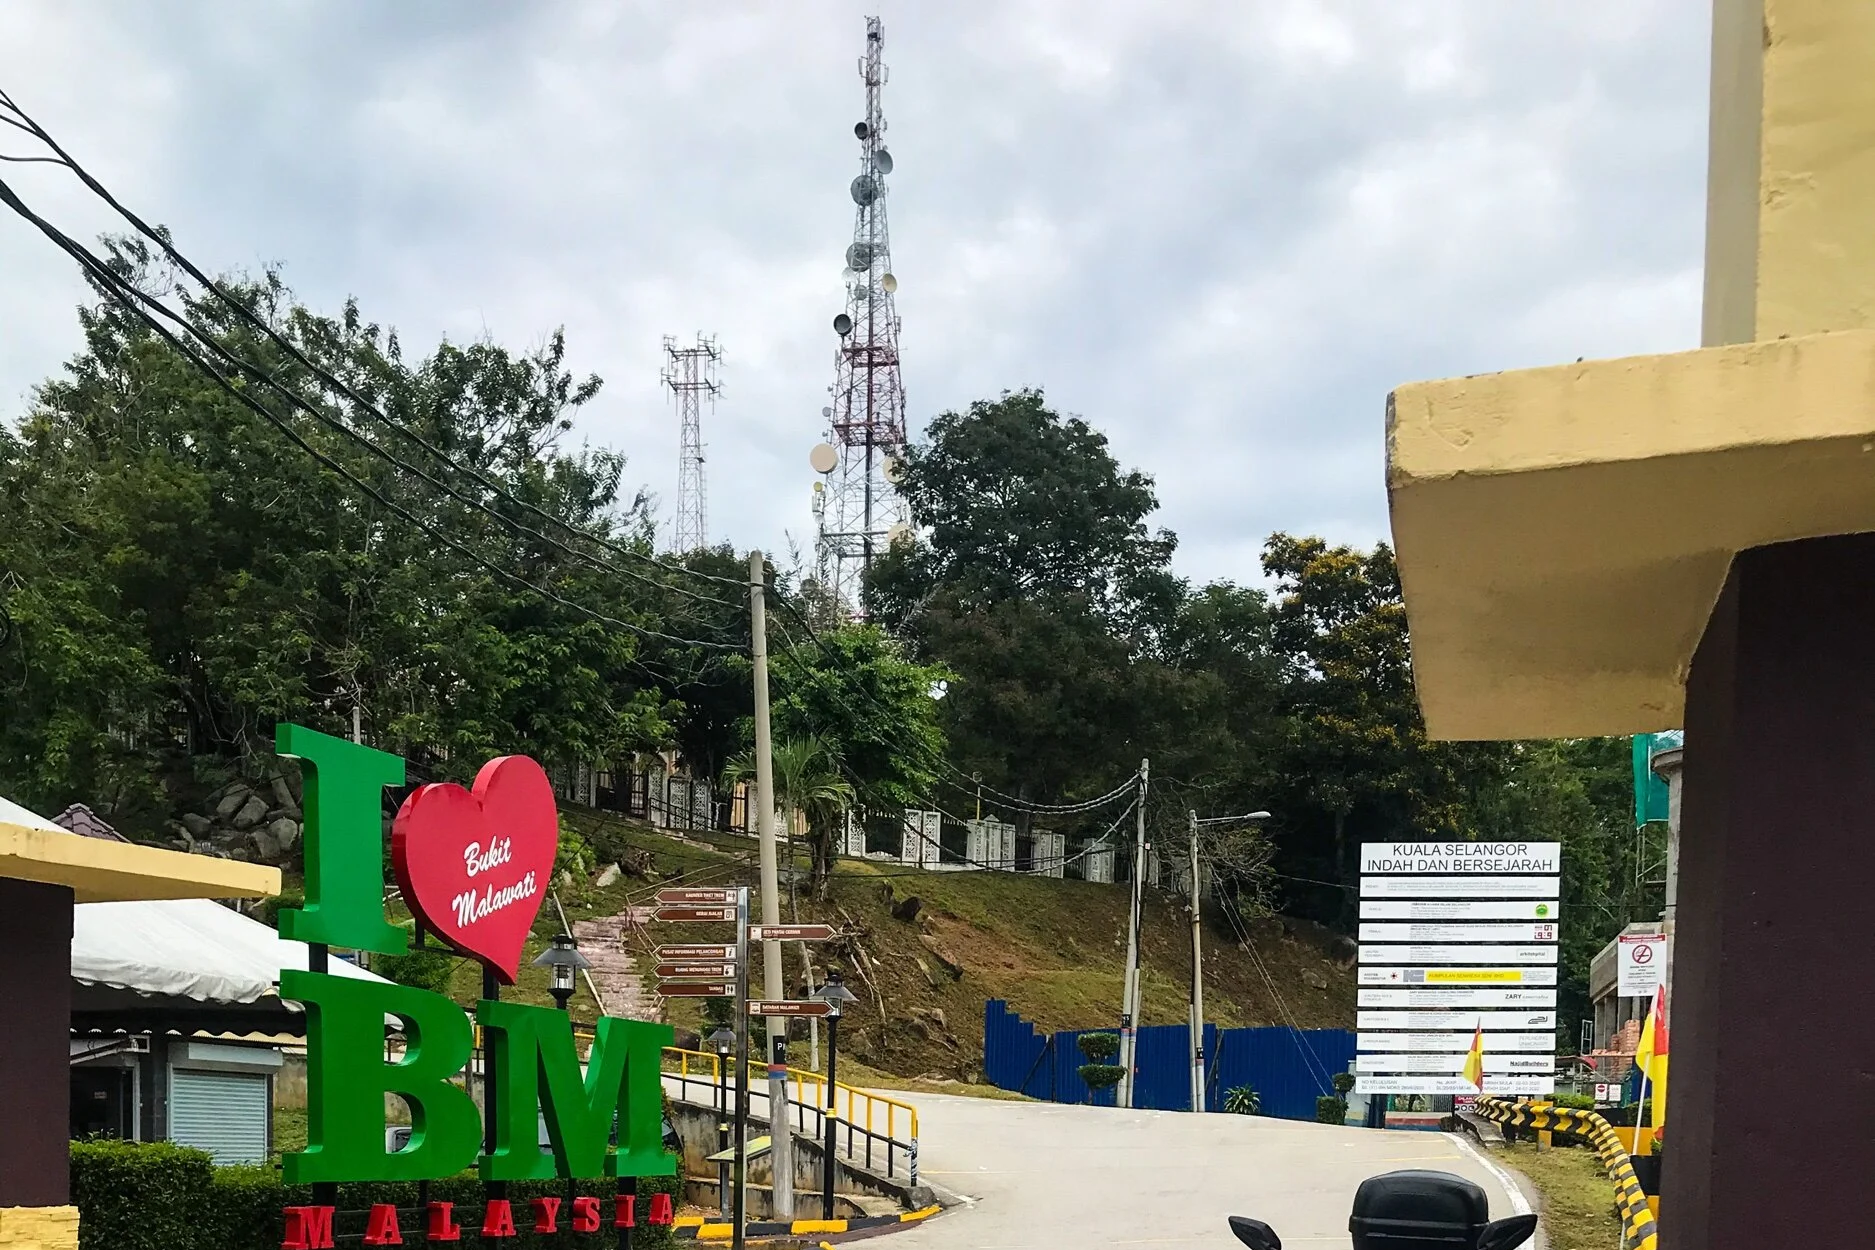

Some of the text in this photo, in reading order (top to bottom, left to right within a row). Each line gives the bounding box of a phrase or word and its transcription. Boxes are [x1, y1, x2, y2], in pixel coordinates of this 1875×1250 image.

[275, 722, 408, 956] I
[463, 834, 513, 878] Bukit
[1367, 859, 1552, 871] INDAH DAN BERSEJARAH
[1393, 844, 1528, 856] KUALA SELANGOR
[451, 870, 538, 929] Malawati
[279, 969, 677, 1183] BM
[280, 1193, 675, 1250] MALAYSIA
